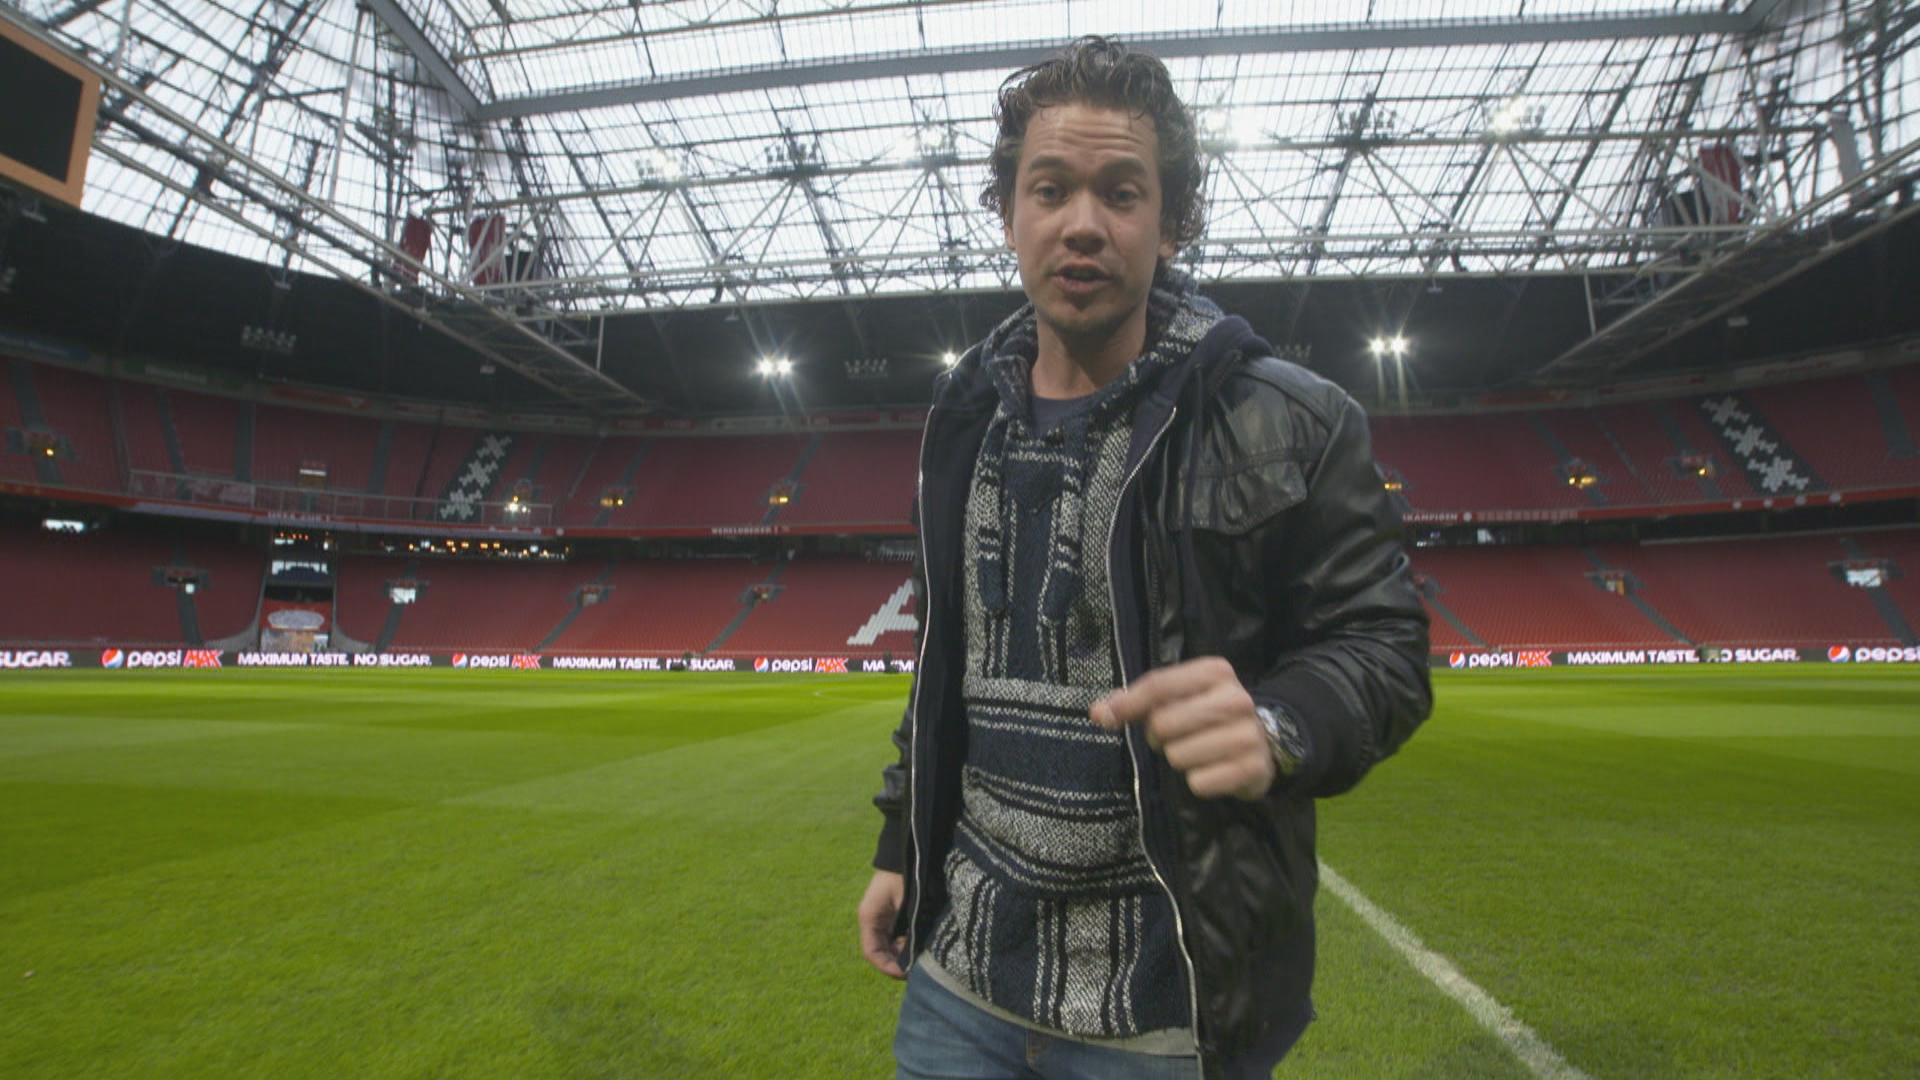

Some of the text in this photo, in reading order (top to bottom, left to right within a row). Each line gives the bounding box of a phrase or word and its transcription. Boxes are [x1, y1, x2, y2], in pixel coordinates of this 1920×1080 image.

[127, 650, 222, 668] pepsi MAX
[237, 652, 431, 666] MAXIMUM TASTE. NO SUGAR.
[470, 654, 542, 669] pepsi MAX
[552, 656, 616, 669] MAXIMUM
[619, 657, 660, 670] TASTE.
[1468, 650, 1552, 669] pepsi MAX
[1567, 651, 1645, 665] MAXIMUM
[1648, 650, 1699, 663] TASTE.
[1735, 648, 1800, 662] SUGAR.
[771, 657, 849, 673] pepsi MAX
